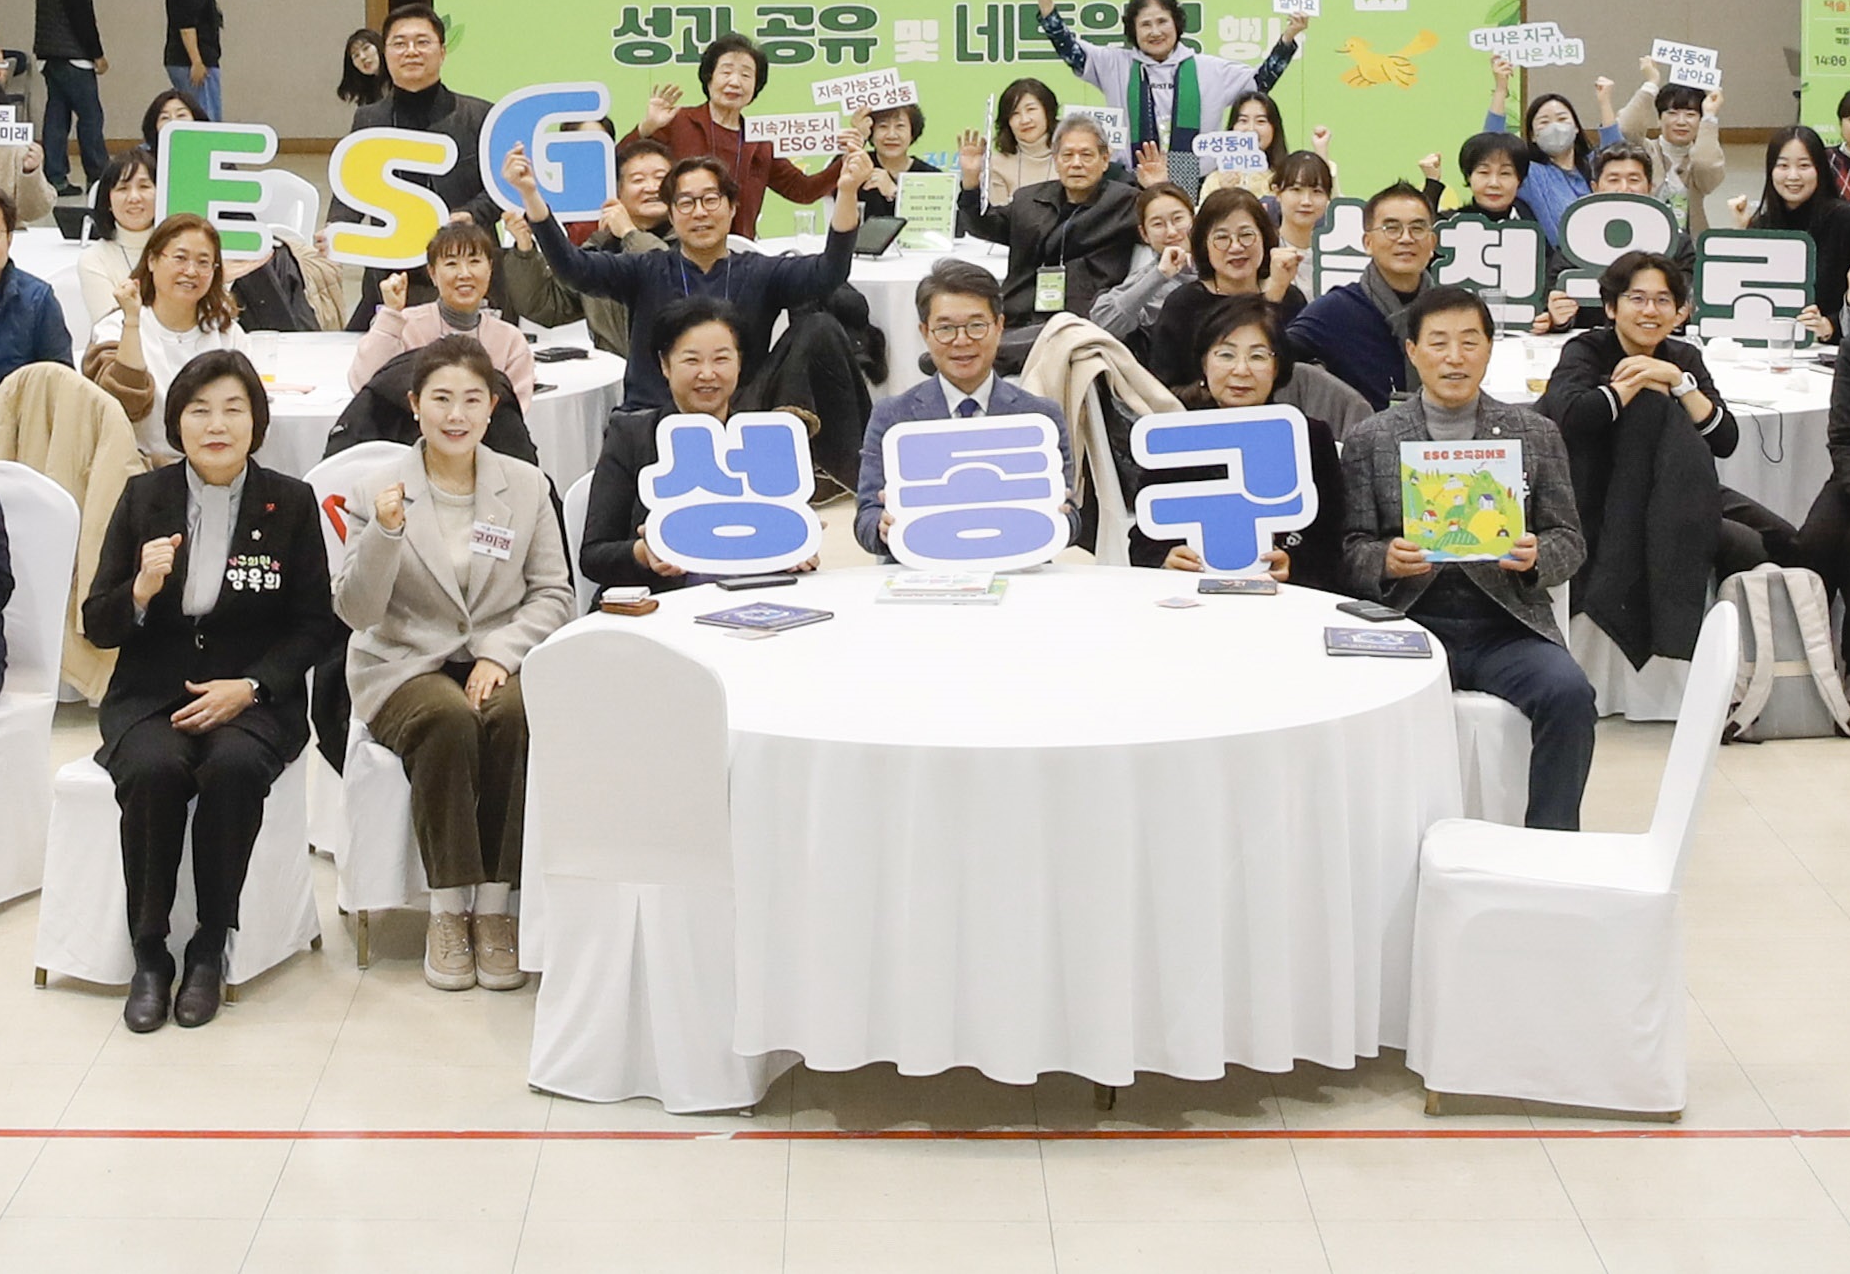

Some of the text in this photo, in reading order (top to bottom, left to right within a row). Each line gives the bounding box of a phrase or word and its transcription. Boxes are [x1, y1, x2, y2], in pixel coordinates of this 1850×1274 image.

[611, 5, 739, 66] 성과
[754, 3, 880, 66] 공유
[893, 19, 939, 64] 및
[954, 2, 1204, 65] 네트워
[1474, 32, 1489, 47] 더
[1492, 28, 1521, 46] 나은
[1515, 46, 1544, 63] 나은
[1549, 43, 1580, 61] 사회
[1656, 45, 1712, 69] #성동에
[816, 73, 896, 100] 지속가능도시
[1676, 66, 1717, 87] 살아요
[845, 87, 913, 112] ESG 성동
[0, 126, 30, 143] 미래
[750, 117, 836, 137] 지속가능도시
[779, 135, 818, 153] ESG
[1197, 135, 1254, 153] #성동에
[1221, 153, 1263, 171] 살아요
[165, 87, 611, 261] ESG
[653, 413, 1307, 572] 성동구
[237, 554, 271, 570] 구의원
[226, 567, 282, 593] 양옥희
